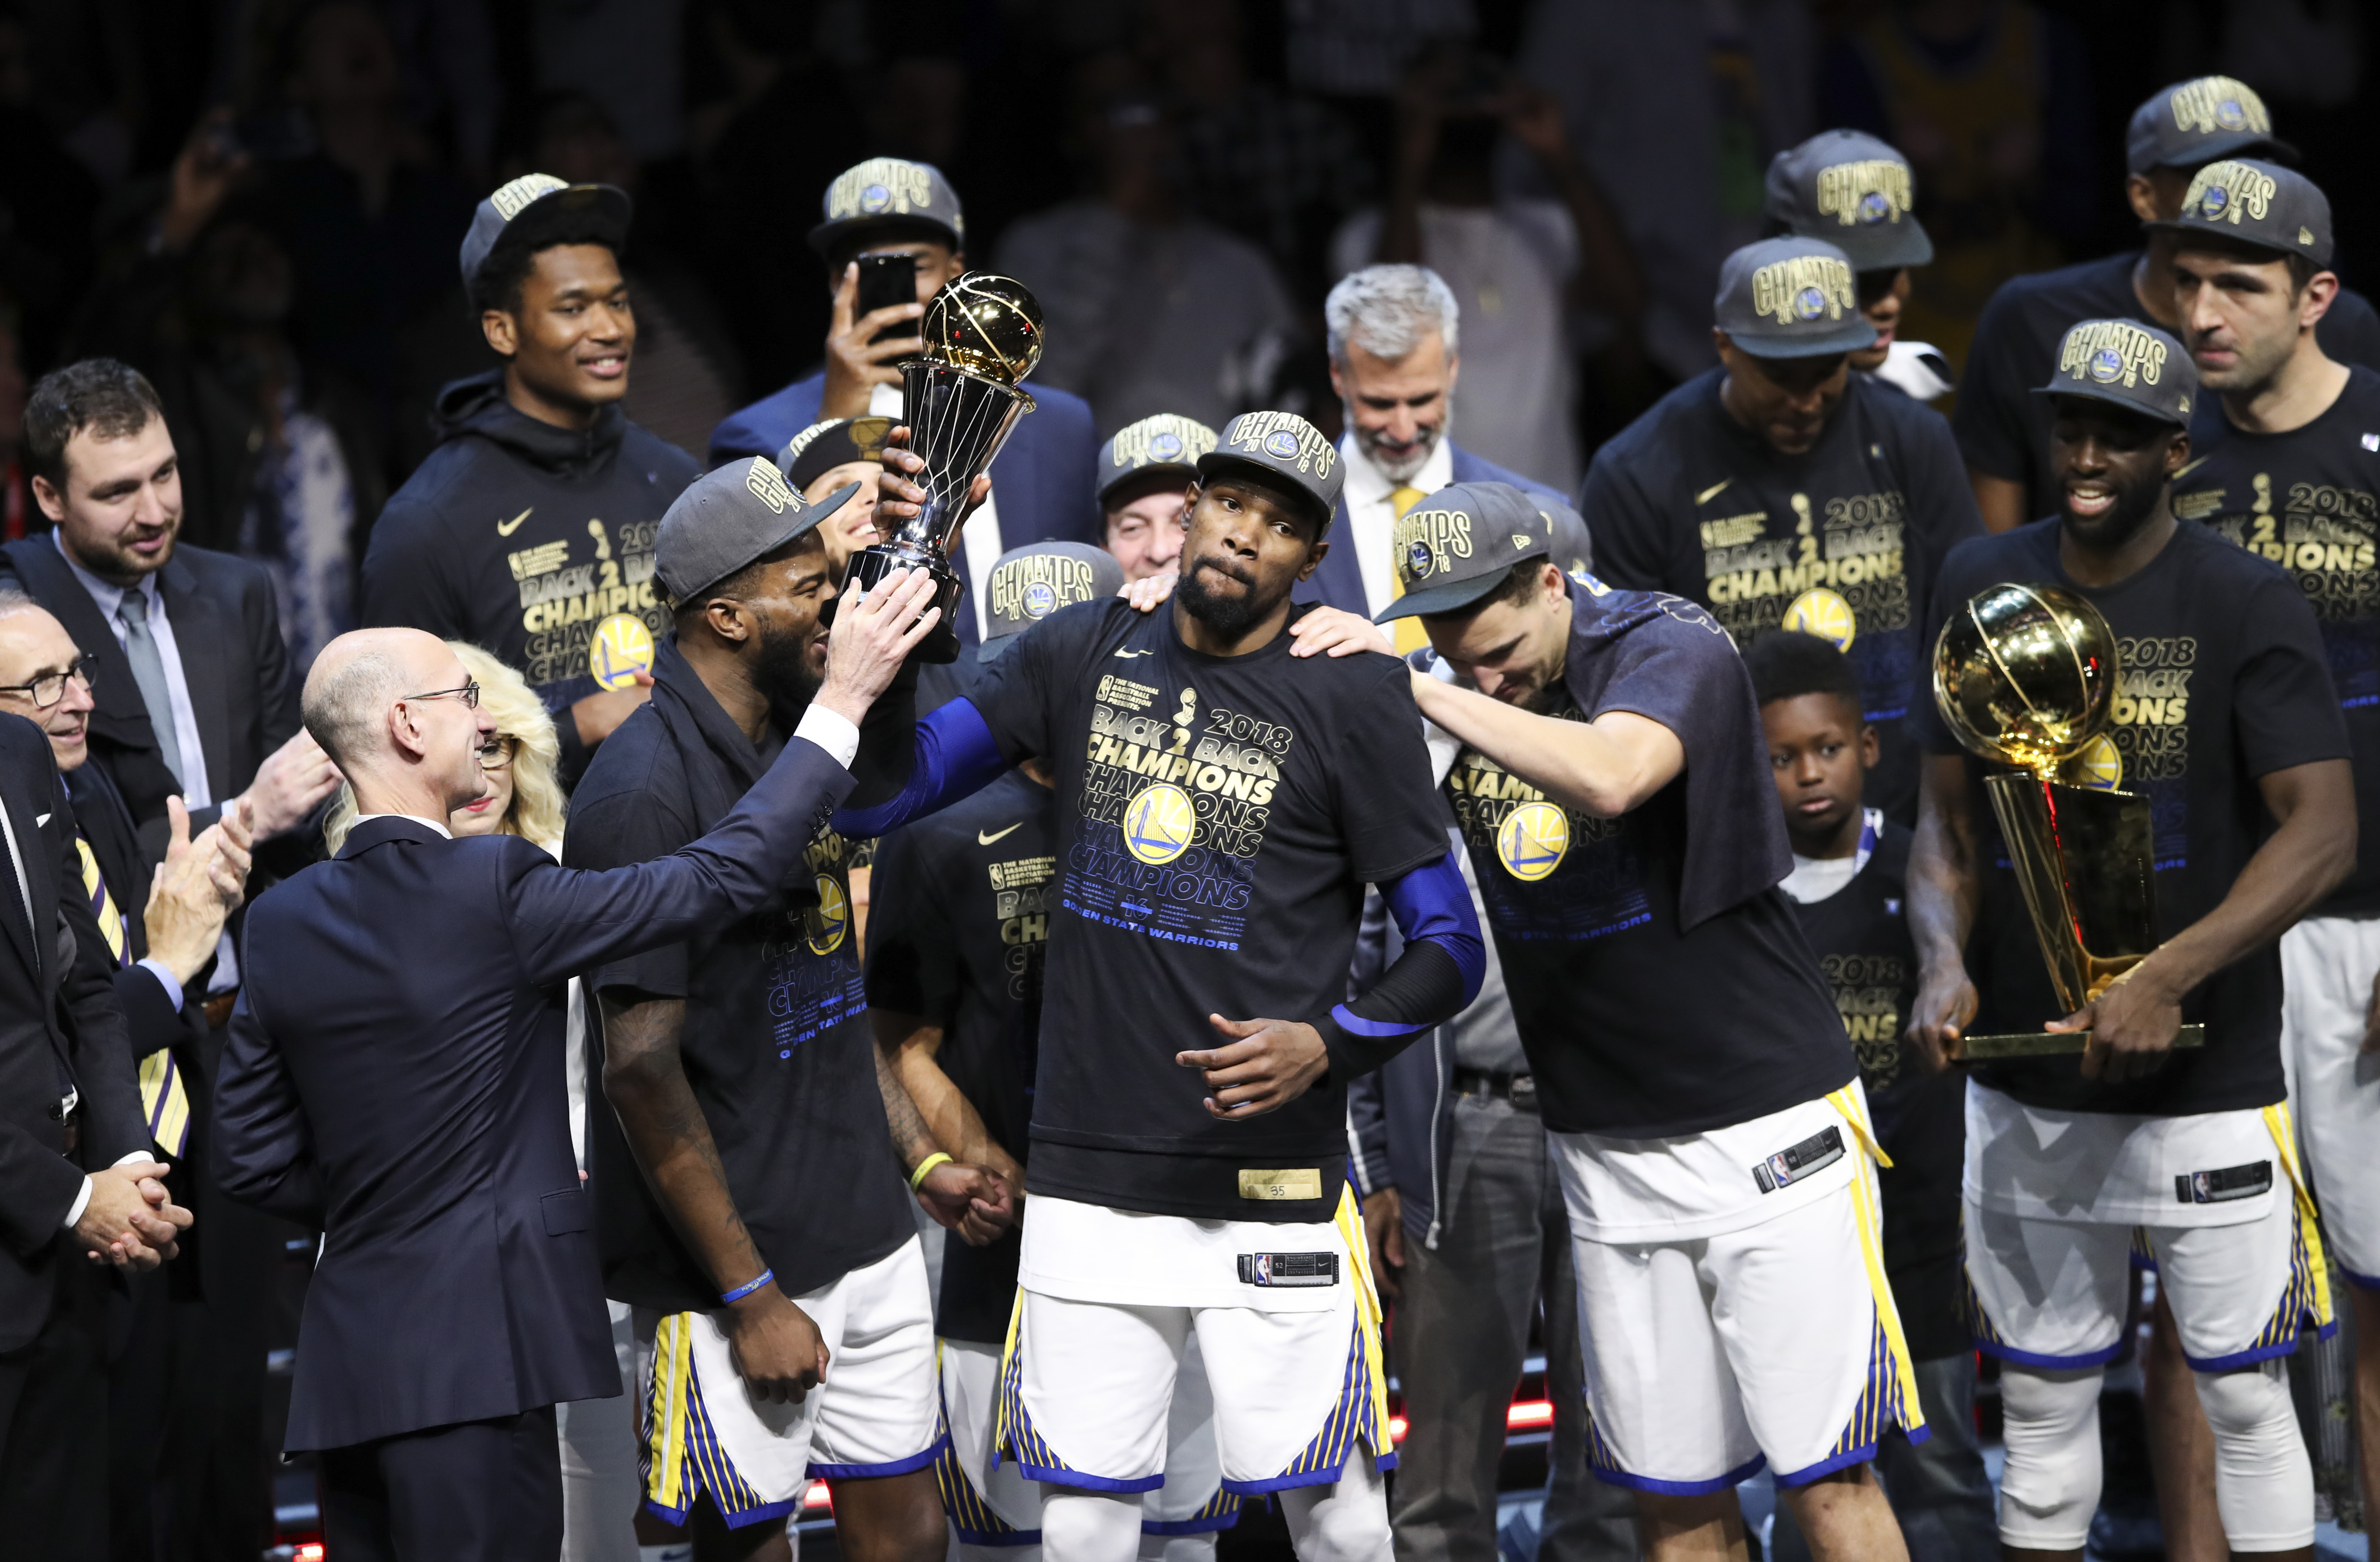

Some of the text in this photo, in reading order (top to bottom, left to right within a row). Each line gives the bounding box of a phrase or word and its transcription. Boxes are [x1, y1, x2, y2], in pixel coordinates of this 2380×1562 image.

[1753, 255, 1855, 317] CHAMPS
[2060, 322, 2167, 386] CHAMPS
[1229, 411, 1335, 481] CHAMPS
[1243, 439, 1259, 453] 20
[1297, 454, 1310, 473] 18
[1823, 491, 1905, 531] 2018
[2252, 514, 2276, 543] 2
[1393, 510, 1473, 559] HAMPS
[1799, 535, 1818, 566] 2
[1826, 521, 1904, 560] BACK
[2247, 541, 2376, 572] PIONS
[519, 563, 595, 608] BACK
[599, 559, 621, 589] 2
[993, 554, 1093, 615] CHAMPS
[1437, 555, 1451, 573] 18
[1708, 549, 1904, 604] CHAMPIONS
[523, 581, 659, 633] CHAMPIO
[1711, 574, 1908, 627] CHAONS
[2117, 636, 2197, 667] 2018
[1090, 704, 1285, 782] BACK 2 BACK
[1203, 709, 1293, 755] 2018
[1086, 733, 1278, 805] CHAMPIONS
[1083, 761, 1270, 832] CHAONS
[1078, 788, 1263, 858] CHAONS
[1003, 863, 1049, 874] BASKETBALL
[1019, 856, 1056, 866] NATIONAL
[1074, 813, 1256, 883] CHAONS
[1005, 869, 1055, 881] ASSOCIATION
[1069, 841, 1253, 910] CHAMPIONS
[997, 887, 1053, 920] BA
[1124, 894, 1148, 921] 16
[1102, 915, 1146, 933] STATE
[1149, 927, 1239, 951] WARRIORS
[1270, 1185, 1285, 1196] 35
